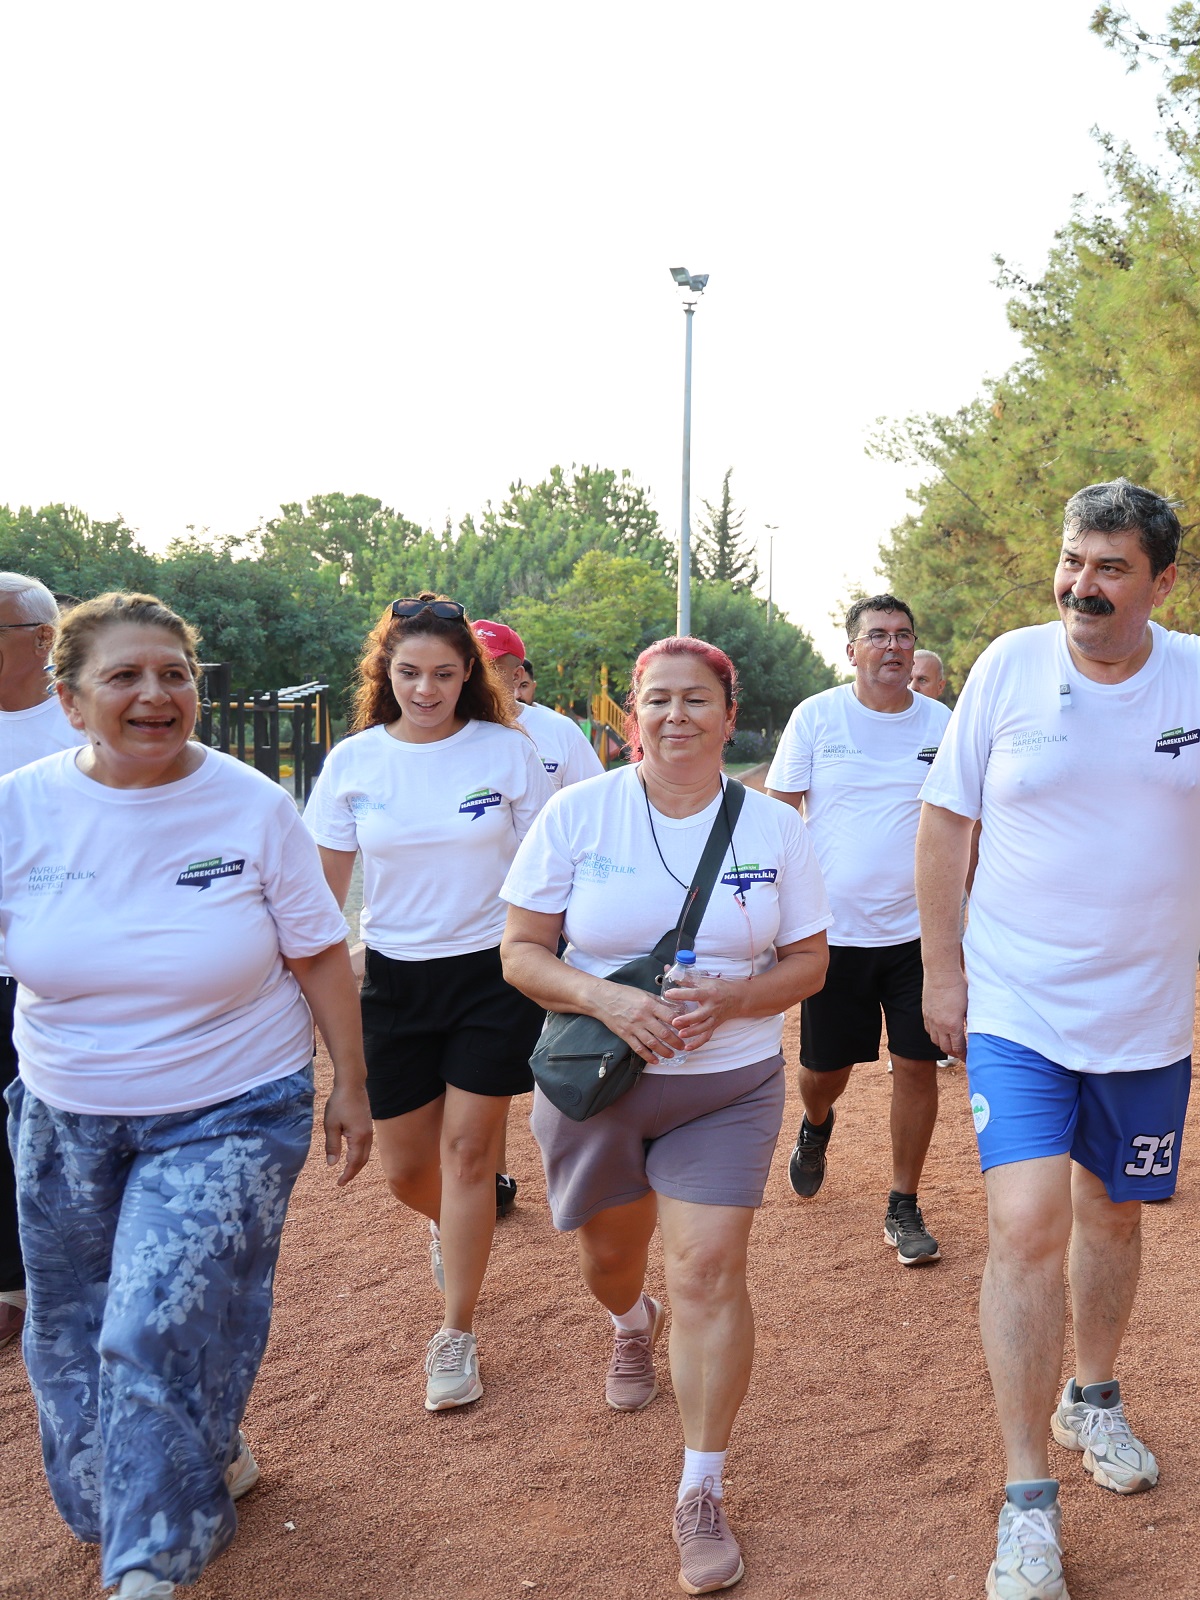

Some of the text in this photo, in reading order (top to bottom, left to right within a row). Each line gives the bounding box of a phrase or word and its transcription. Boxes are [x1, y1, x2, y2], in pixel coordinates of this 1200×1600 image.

[1012, 729, 1043, 741] AVRUPA
[1012, 733, 1068, 747] HAREKETLİLİK
[1157, 732, 1199, 747] HAREKETLİLİK
[1011, 744, 1041, 755] HAFTASI
[180, 863, 242, 880] HAREKETLİLİK
[1123, 1130, 1176, 1177] 33
